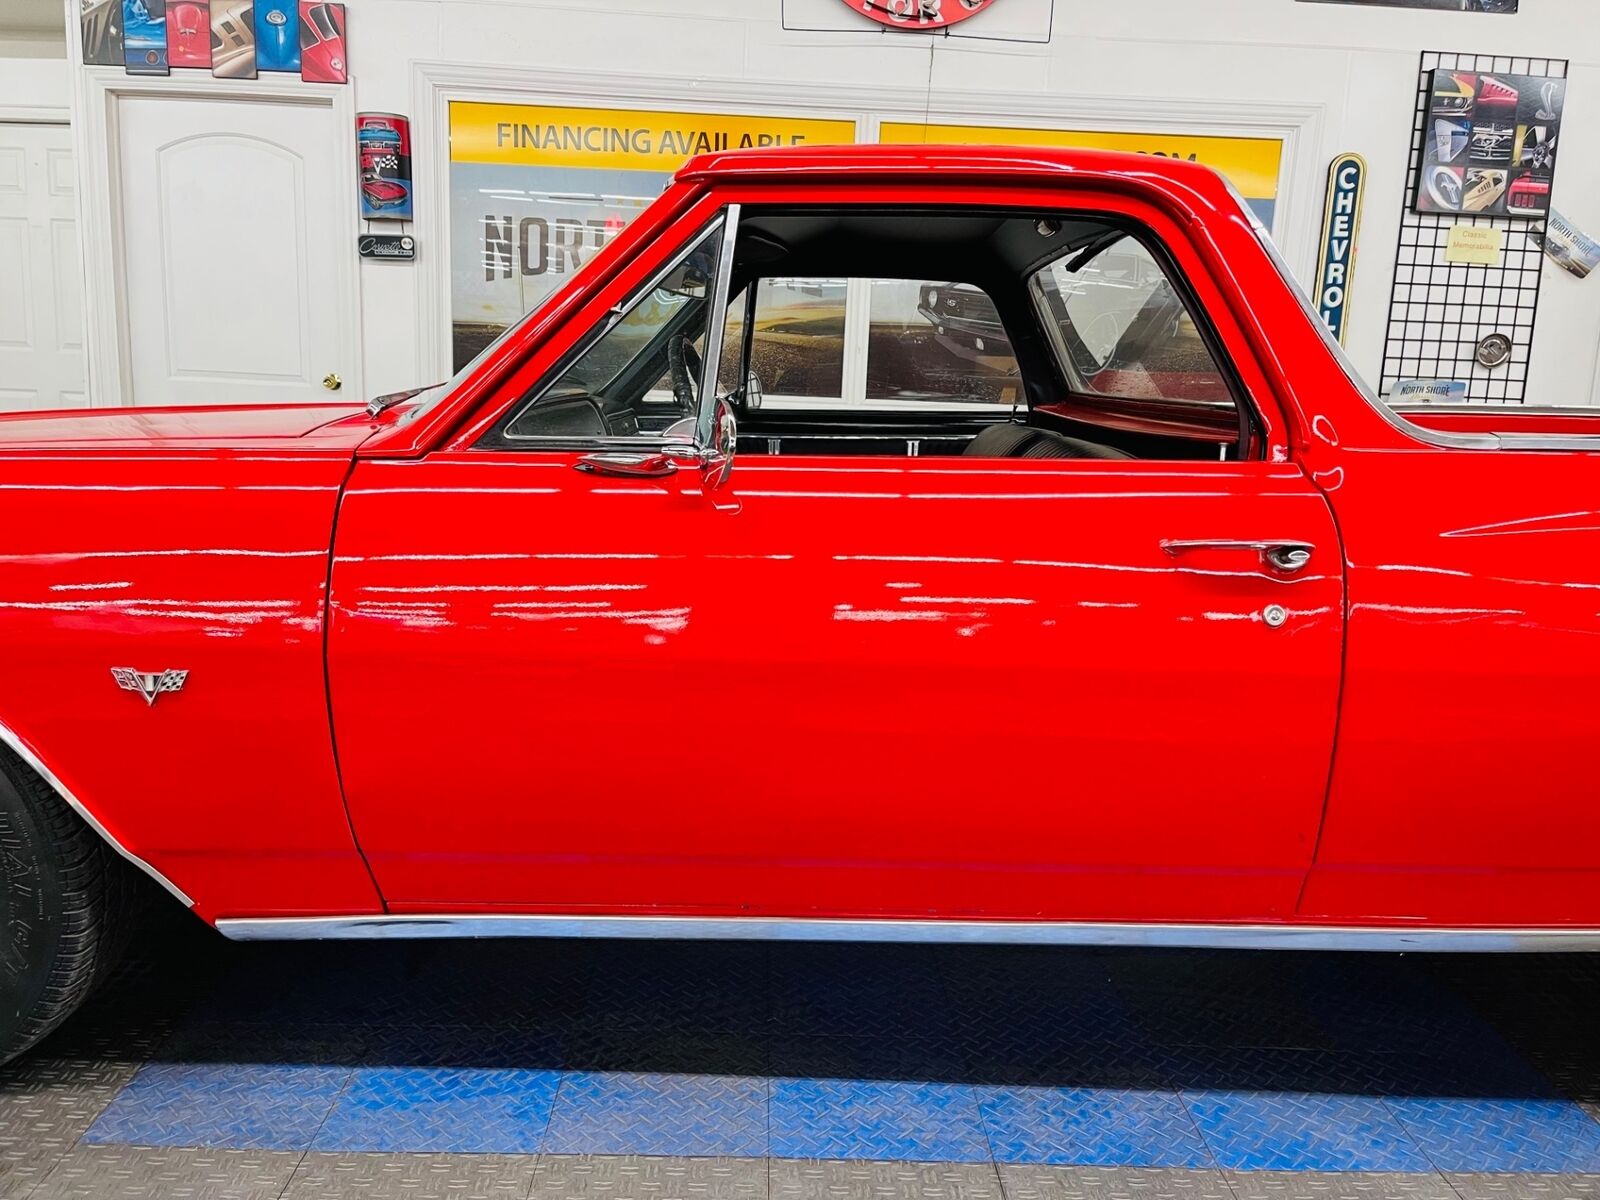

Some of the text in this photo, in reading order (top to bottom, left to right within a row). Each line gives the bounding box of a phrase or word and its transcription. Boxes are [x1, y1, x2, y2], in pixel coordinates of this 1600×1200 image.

[497, 122, 651, 153] FINANCING
[484, 214, 626, 282] NORT
[1400, 384, 1425, 396] NORTH
[1425, 384, 1451, 397] SHORE
